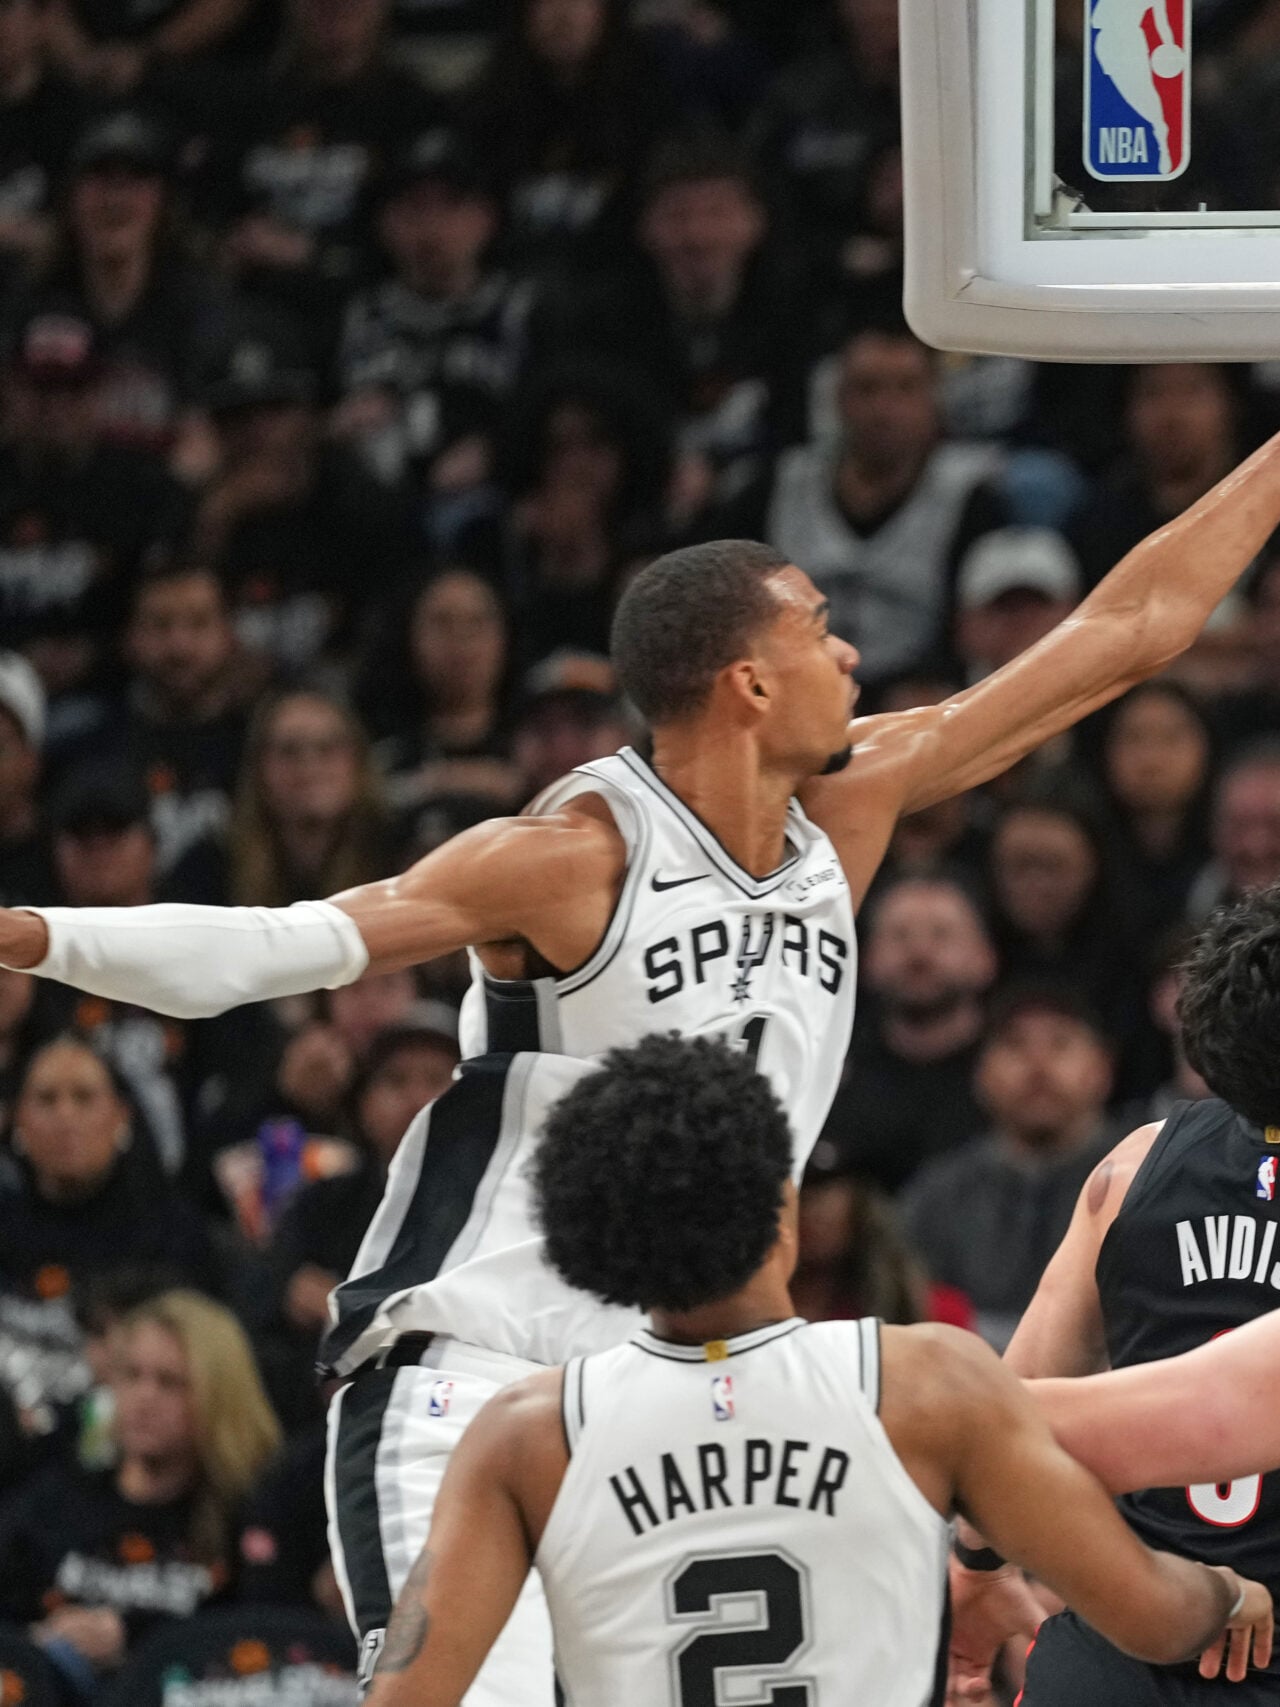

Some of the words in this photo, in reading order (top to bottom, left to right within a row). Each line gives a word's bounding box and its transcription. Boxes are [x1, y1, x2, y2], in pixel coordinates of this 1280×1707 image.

[1099, 127, 1148, 163] NBA
[644, 912, 848, 1004] SPURS
[609, 1439, 850, 1536] HARPER
[662, 1545, 818, 1707] 2
